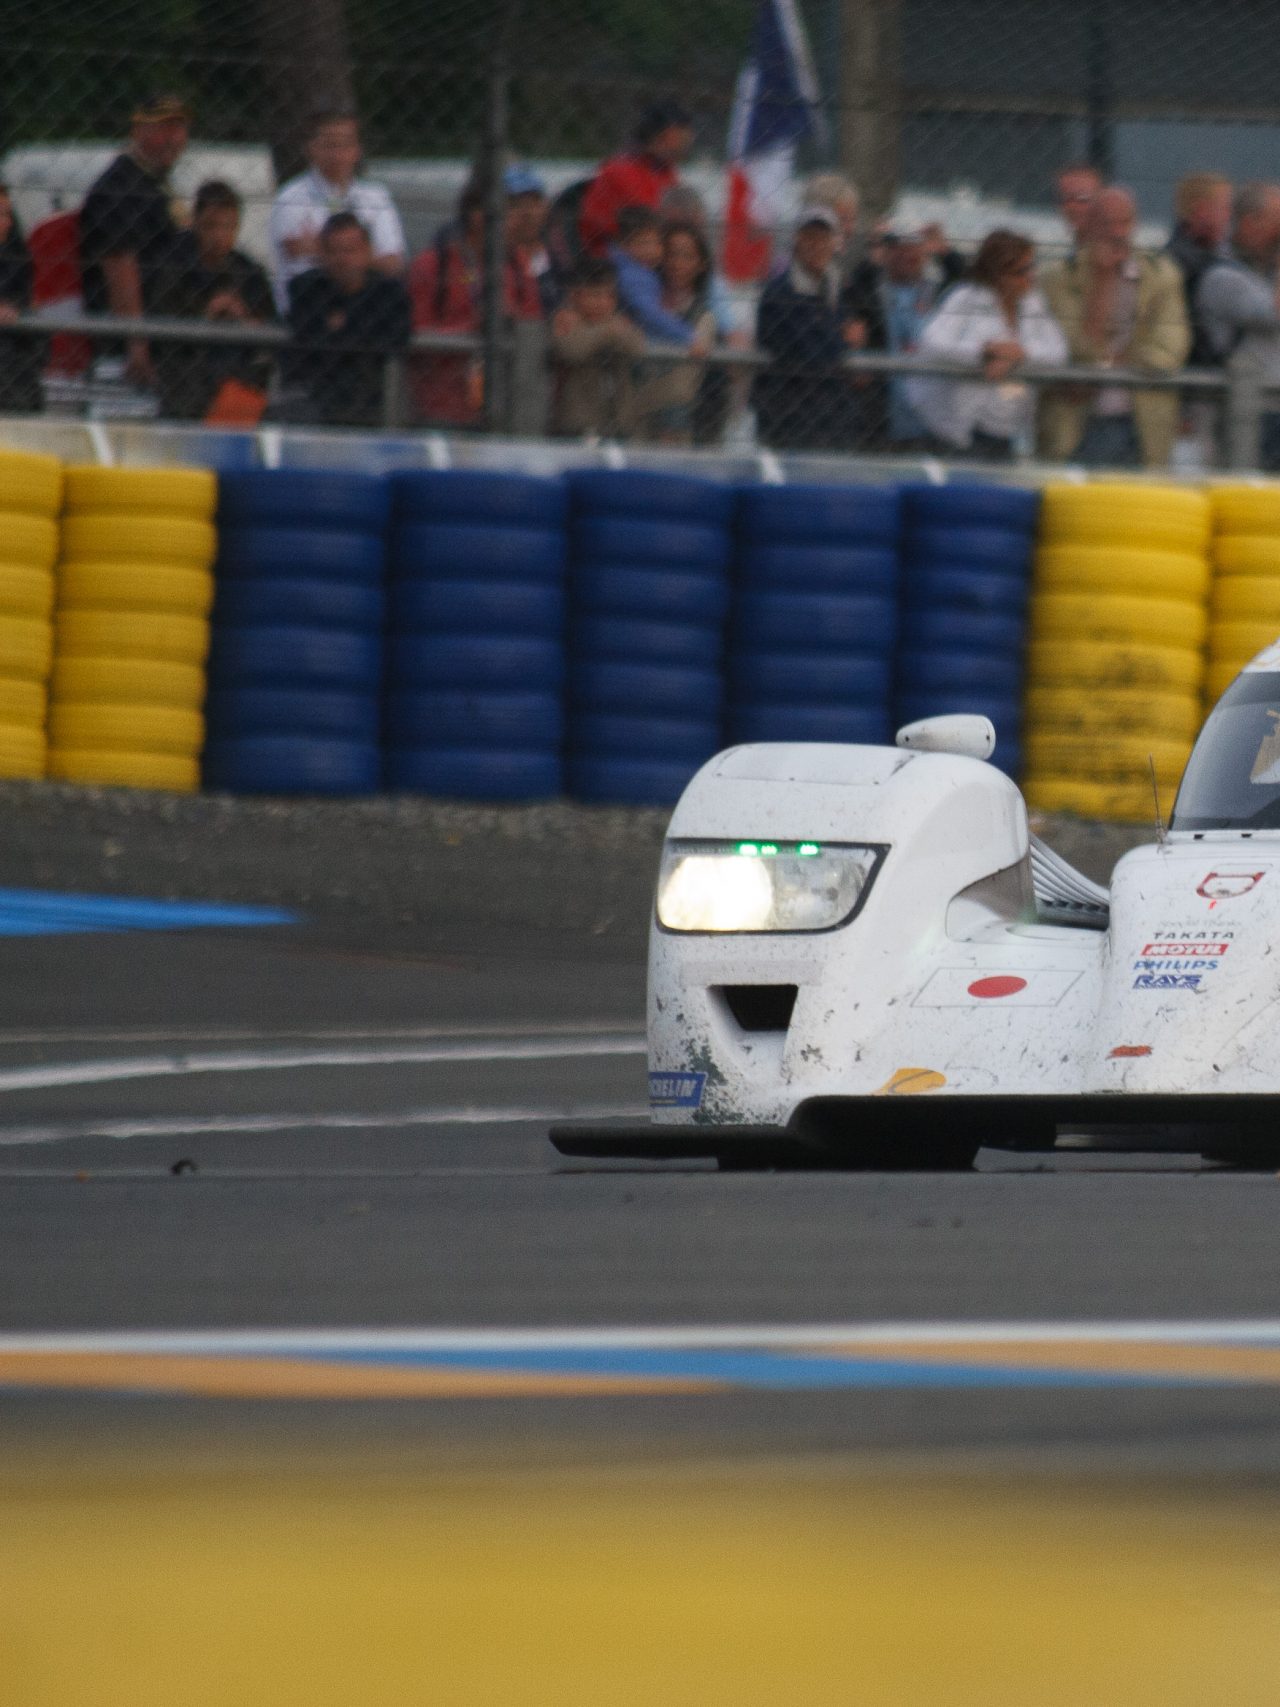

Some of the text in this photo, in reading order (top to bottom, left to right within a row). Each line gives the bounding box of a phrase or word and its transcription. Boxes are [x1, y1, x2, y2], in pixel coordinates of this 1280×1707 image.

[1153, 931, 1234, 940] TAKATA
[1133, 960, 1219, 971] PHILIPS
[1132, 974, 1203, 989] RAYS
